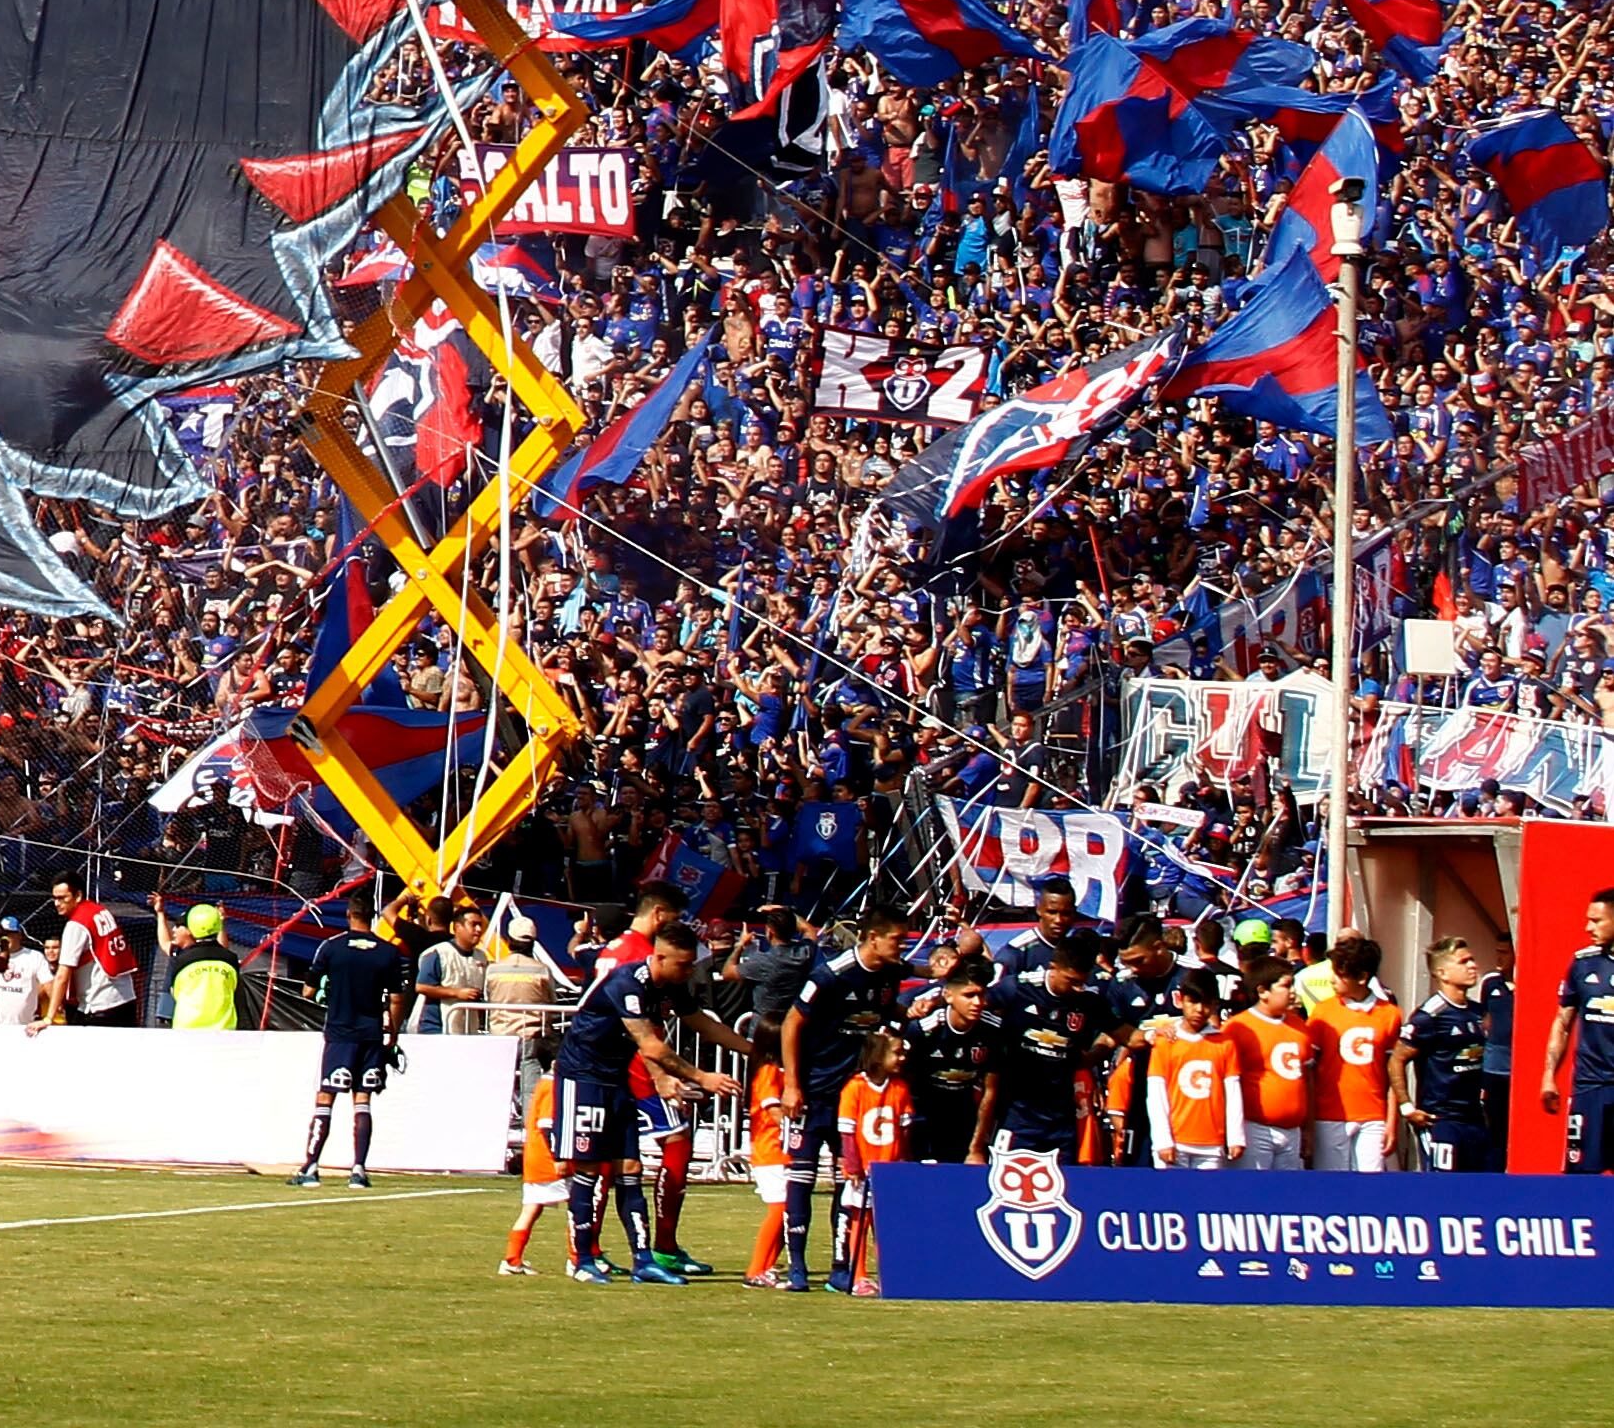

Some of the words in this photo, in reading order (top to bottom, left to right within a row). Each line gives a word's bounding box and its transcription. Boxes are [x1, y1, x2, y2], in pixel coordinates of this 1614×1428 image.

[1272, 1042, 1302, 1080] G
[1340, 1026, 1376, 1065] G
[1177, 1059, 1213, 1100] G
[575, 1105, 606, 1133] 20
[862, 1106, 895, 1146] G
[1004, 1212, 1057, 1261] U
[1098, 1211, 1188, 1252] CLUB
[1198, 1213, 1430, 1255] UNIVERSIDAD
[1440, 1217, 1487, 1255] DE
[1495, 1218, 1596, 1256] CHILE
